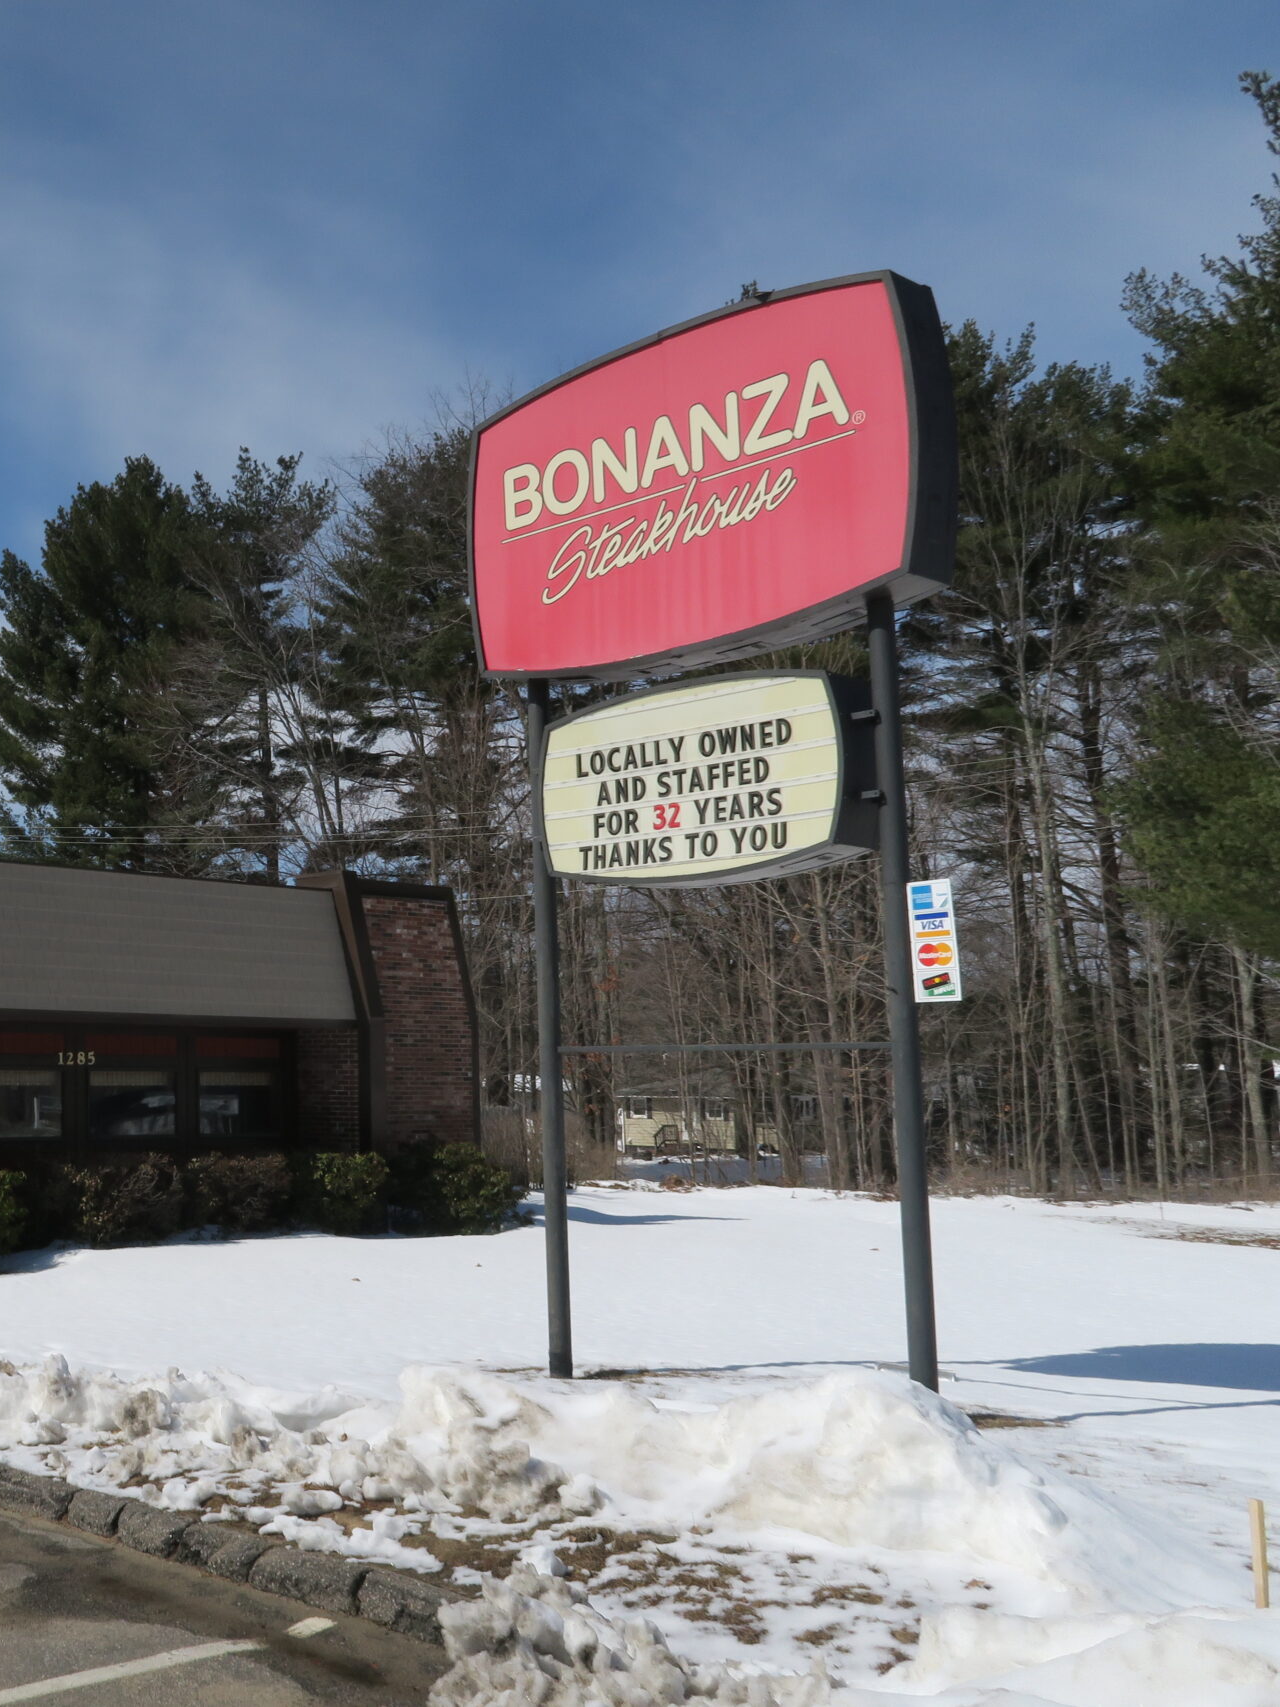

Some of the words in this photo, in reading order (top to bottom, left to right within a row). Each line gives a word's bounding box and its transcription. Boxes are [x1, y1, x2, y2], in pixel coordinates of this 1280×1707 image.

[503, 359, 850, 531] BONANZA
[542, 467, 797, 606] Steakhouse
[576, 735, 685, 778] LOCALLY
[698, 718, 792, 757] OWNED
[597, 776, 646, 806] AND
[658, 756, 769, 798] STAFFED
[593, 808, 639, 838] FOR
[652, 802, 681, 830] 32
[694, 788, 783, 824] YEARS
[579, 836, 673, 871] THANKS
[685, 831, 718, 859] TO
[730, 821, 787, 851] YOU
[921, 920, 944, 930] VISA
[58, 1052, 96, 1065] 1285
